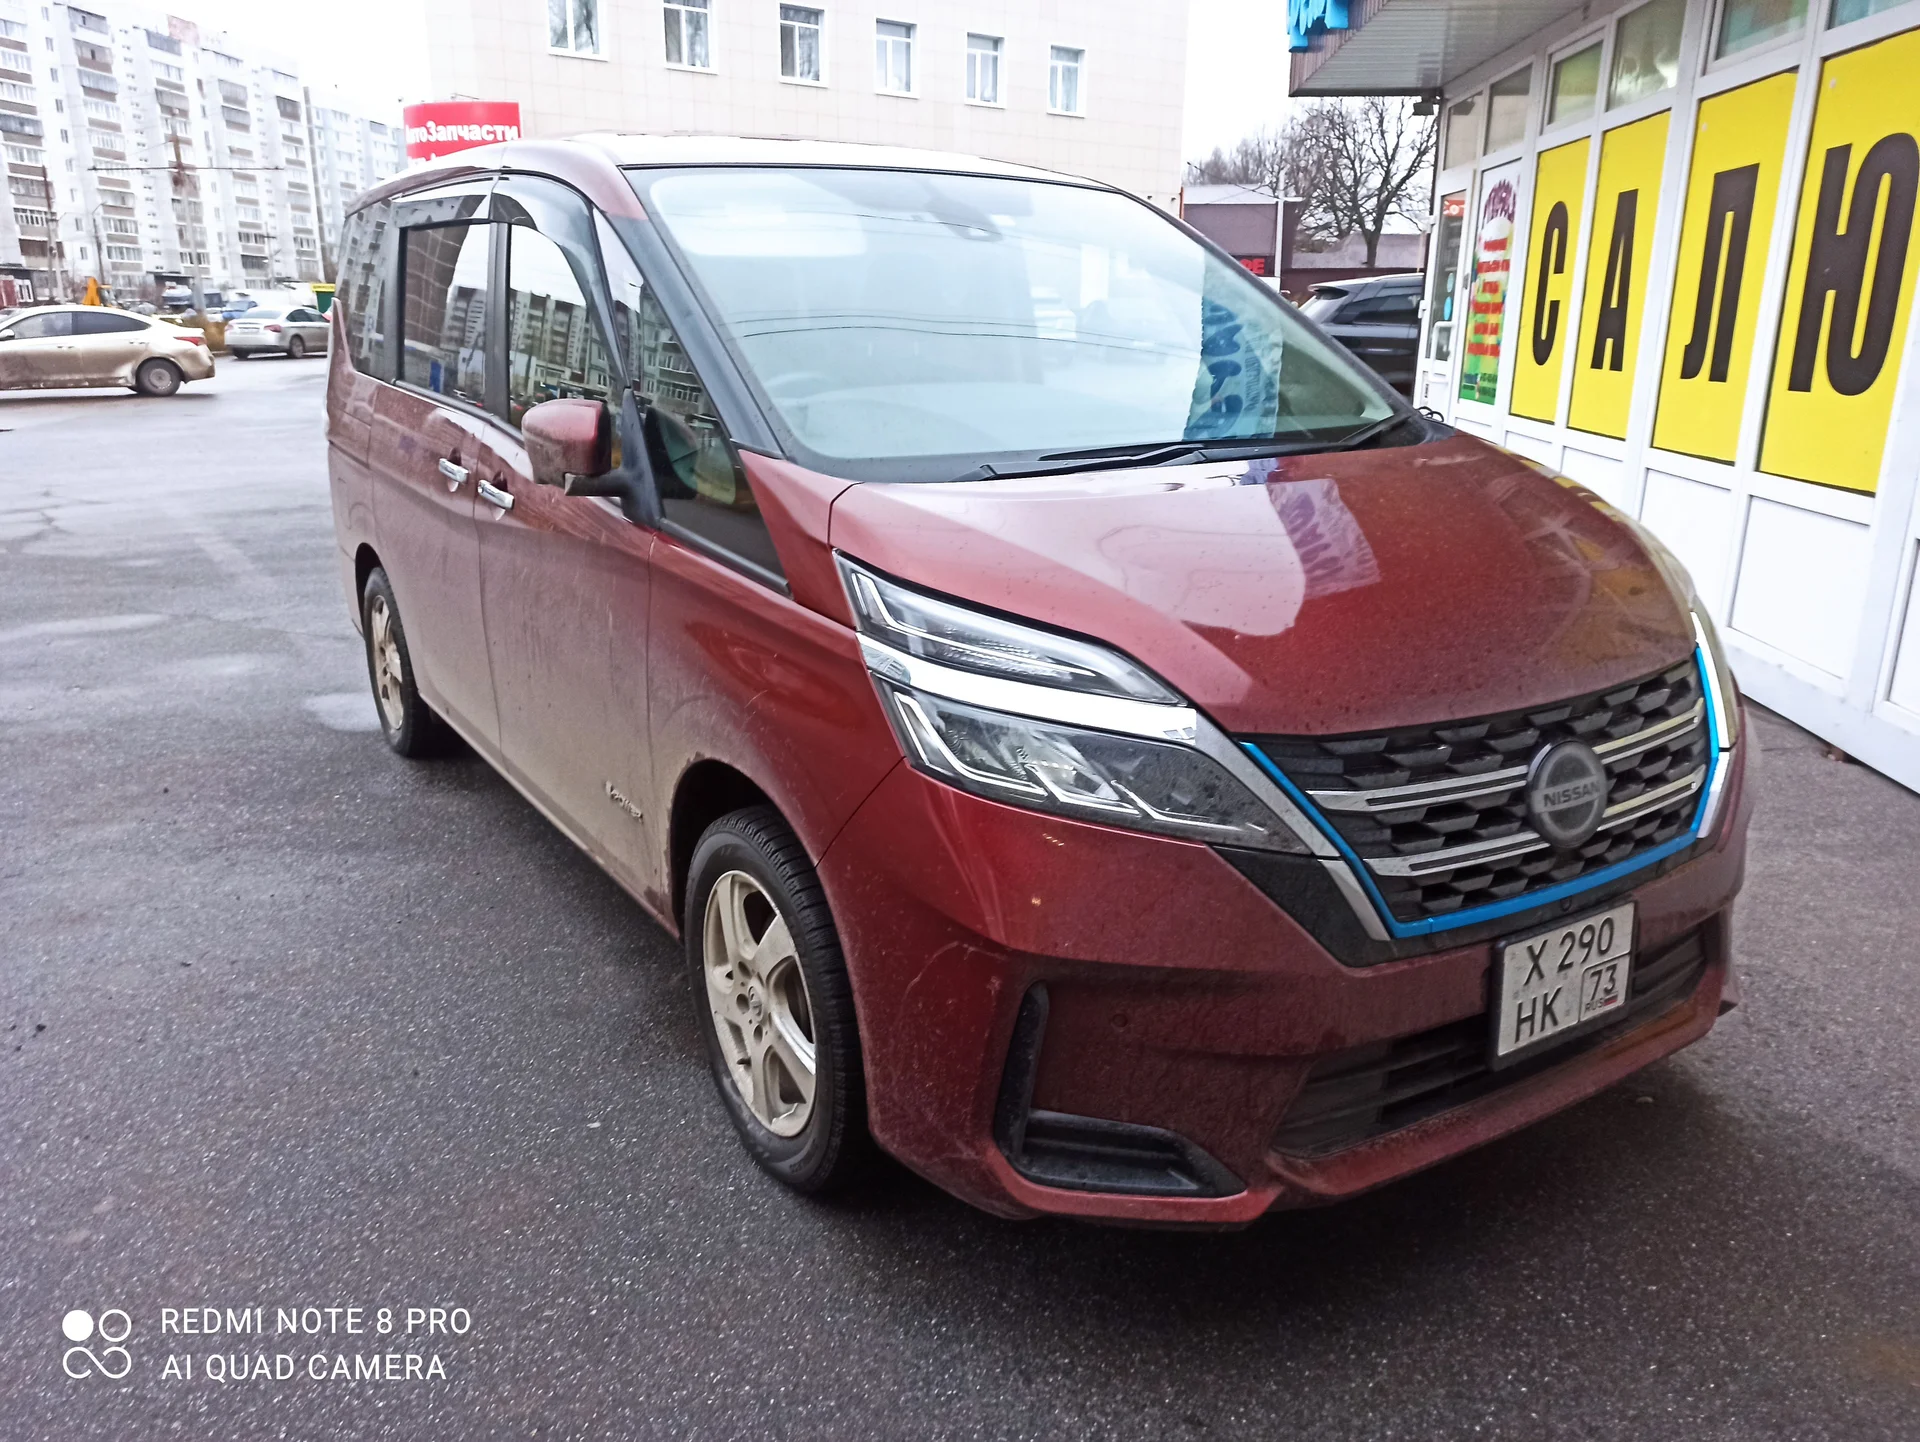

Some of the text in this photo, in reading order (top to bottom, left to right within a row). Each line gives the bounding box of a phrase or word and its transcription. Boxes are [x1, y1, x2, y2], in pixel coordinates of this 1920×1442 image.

[1543, 780, 1601, 807] NISSAN
[1556, 916, 1615, 974] 290
[1589, 962, 1618, 1002] 73
[1584, 998, 1604, 1014] RUS
